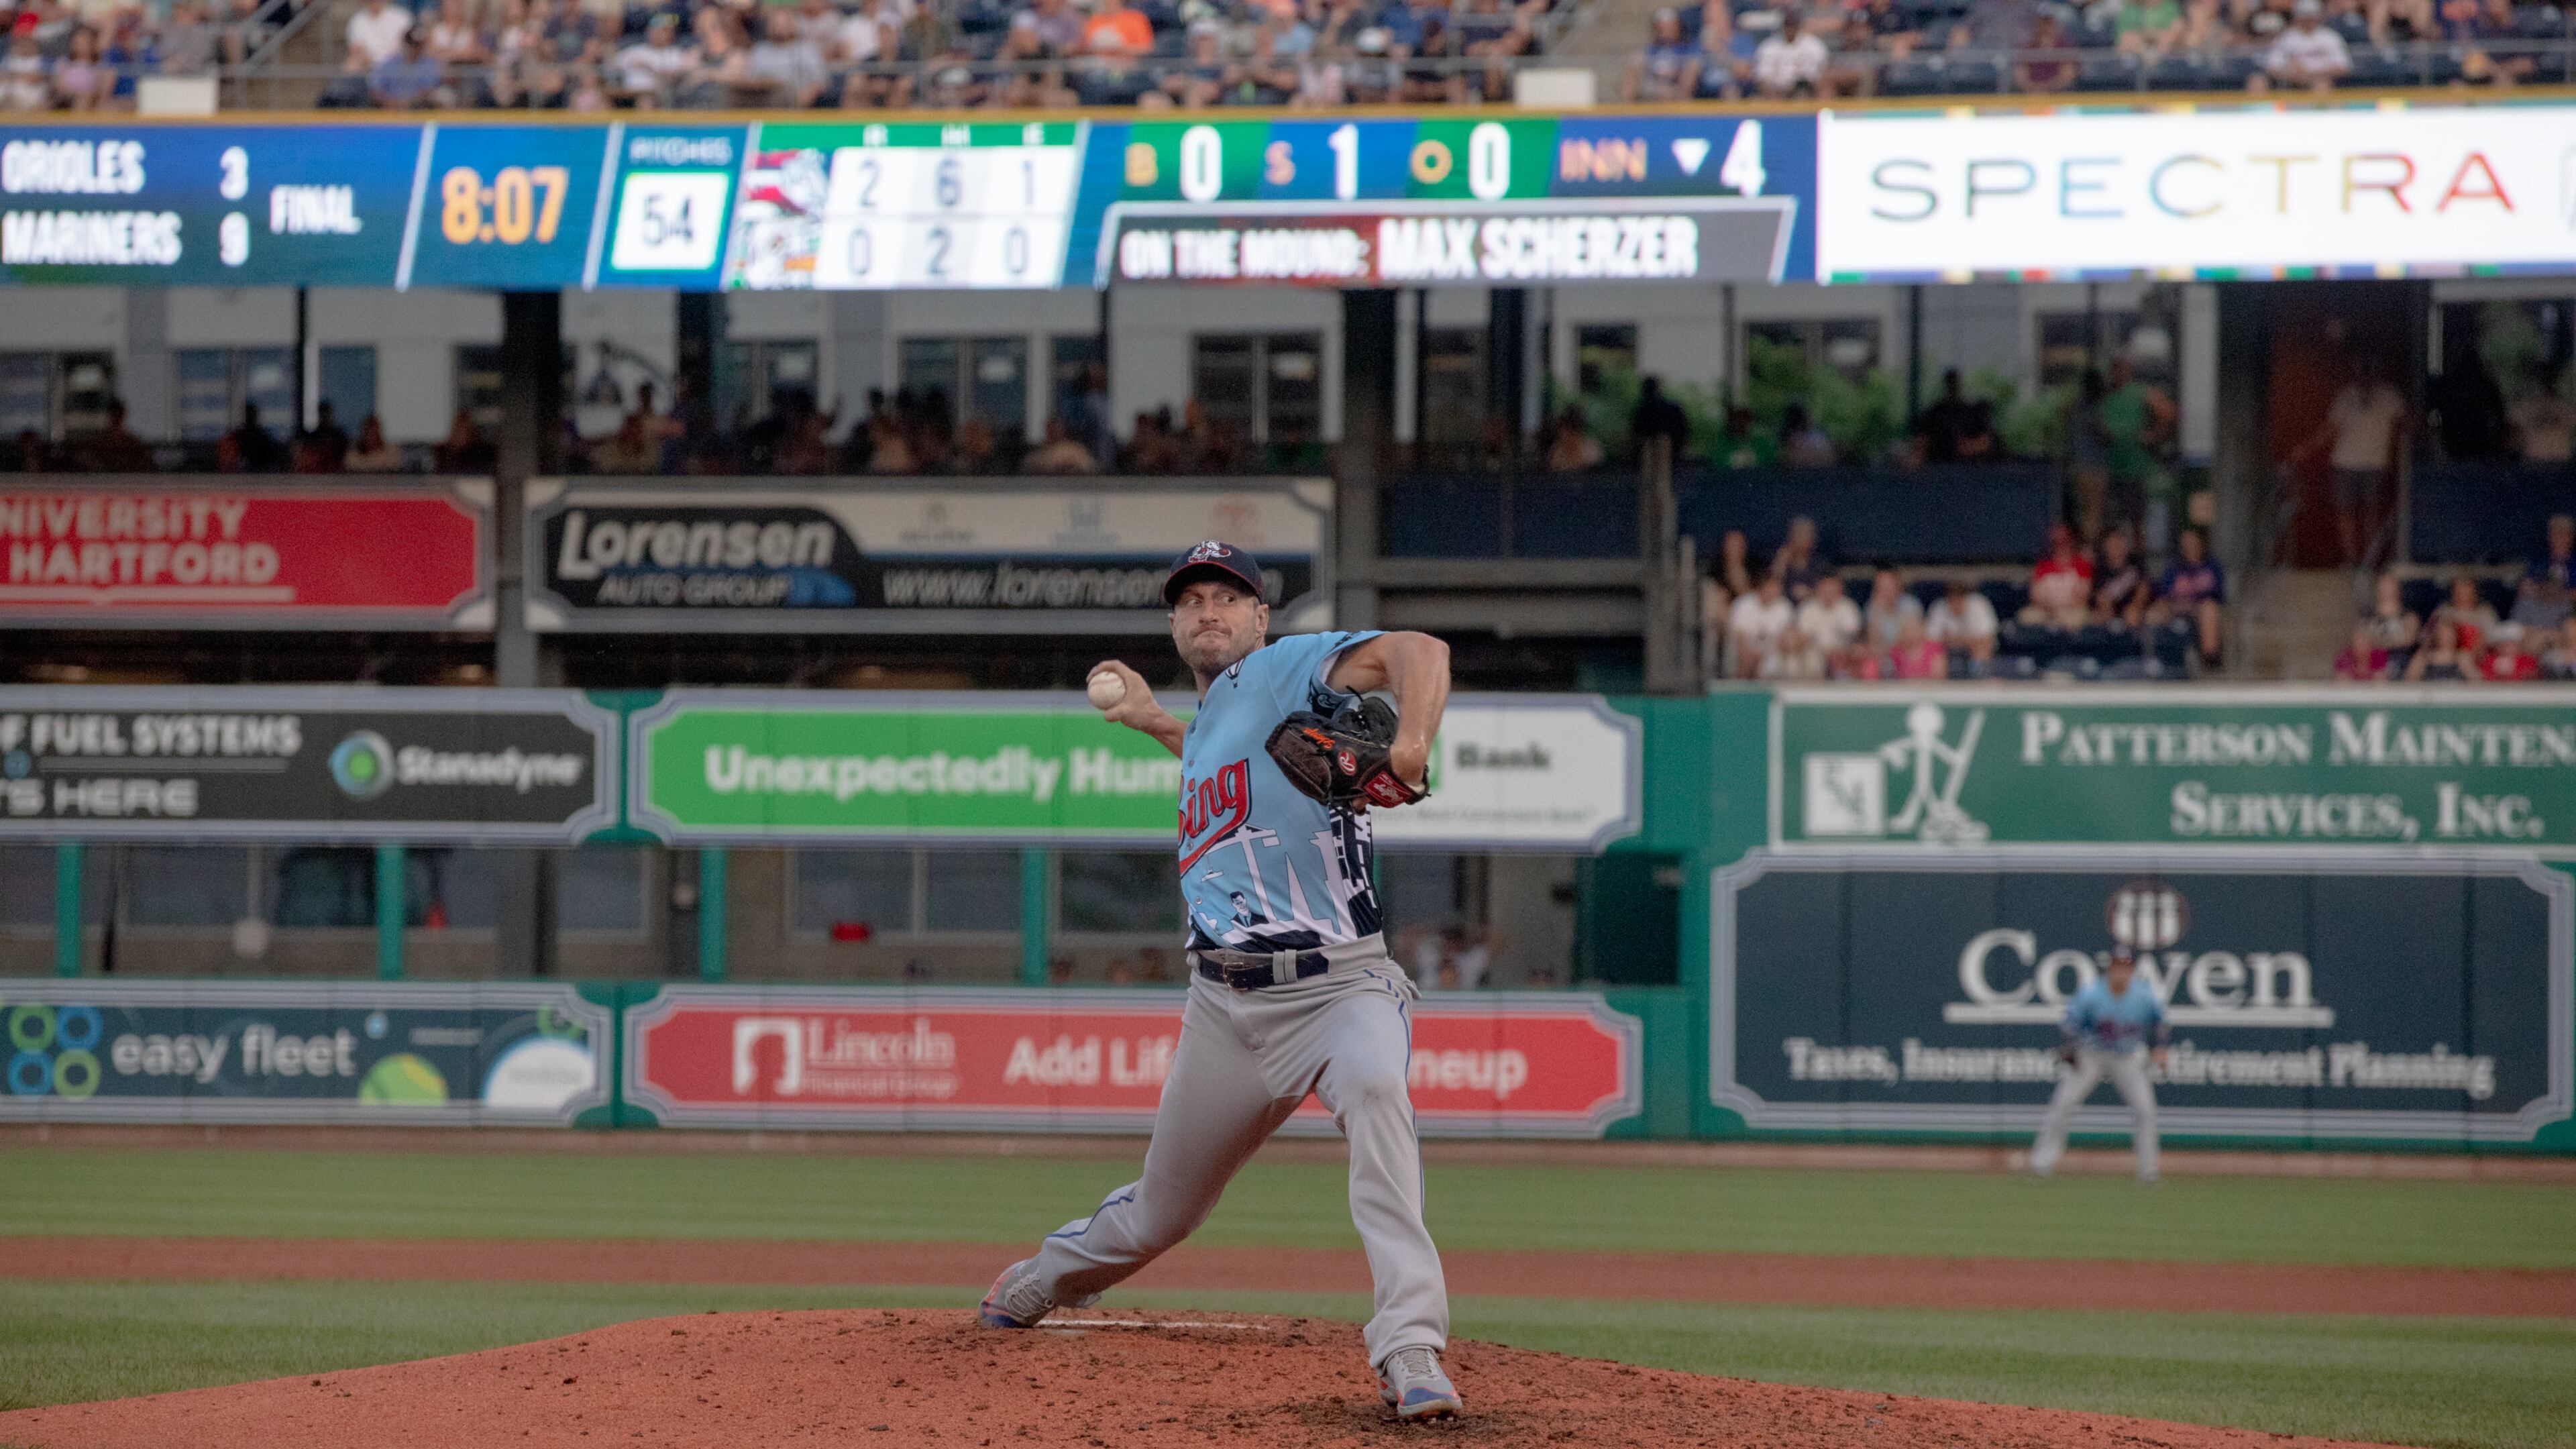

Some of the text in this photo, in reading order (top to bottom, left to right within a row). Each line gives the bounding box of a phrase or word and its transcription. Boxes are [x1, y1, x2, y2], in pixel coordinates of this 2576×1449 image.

[1, 140, 249, 200] ORIOLES 3
[857, 157, 1034, 208] 2 6 1
[1124, 142, 1158, 186] B
[1180, 125, 1222, 201] 0
[1265, 140, 1295, 185] S
[1329, 123, 1358, 199] 1
[1468, 122, 1511, 200] 0
[1560, 138, 1647, 181] INN
[1721, 119, 1766, 197] 4
[1870, 151, 2516, 221] SPECTRA
[270, 184, 362, 234] FINAL
[442, 166, 569, 244] 8:07
[642, 195, 694, 248] 54
[1, 212, 249, 266] MARINERS 9
[849, 225, 1030, 277] 0 2 0
[1120, 216, 1698, 279] ON THE MOUND: MAX SCHERZER
[9, 542, 279, 584] HARTFORD
[557, 510, 836, 580] Lorensen
[32, 714, 128, 756] FUEL
[132, 714, 302, 757] SYSTEMS
[1456, 741, 1552, 771] Bank
[398, 746, 584, 792] Stanadyne
[704, 745, 1182, 802] Unexpectedly Hum
[54, 777, 199, 816] HERE
[111, 1024, 357, 1083] easy fleet
[1003, 1034, 1101, 1086] Add
[1108, 1034, 1174, 1087] Lif
[2328, 1040, 2496, 1100] Planning
